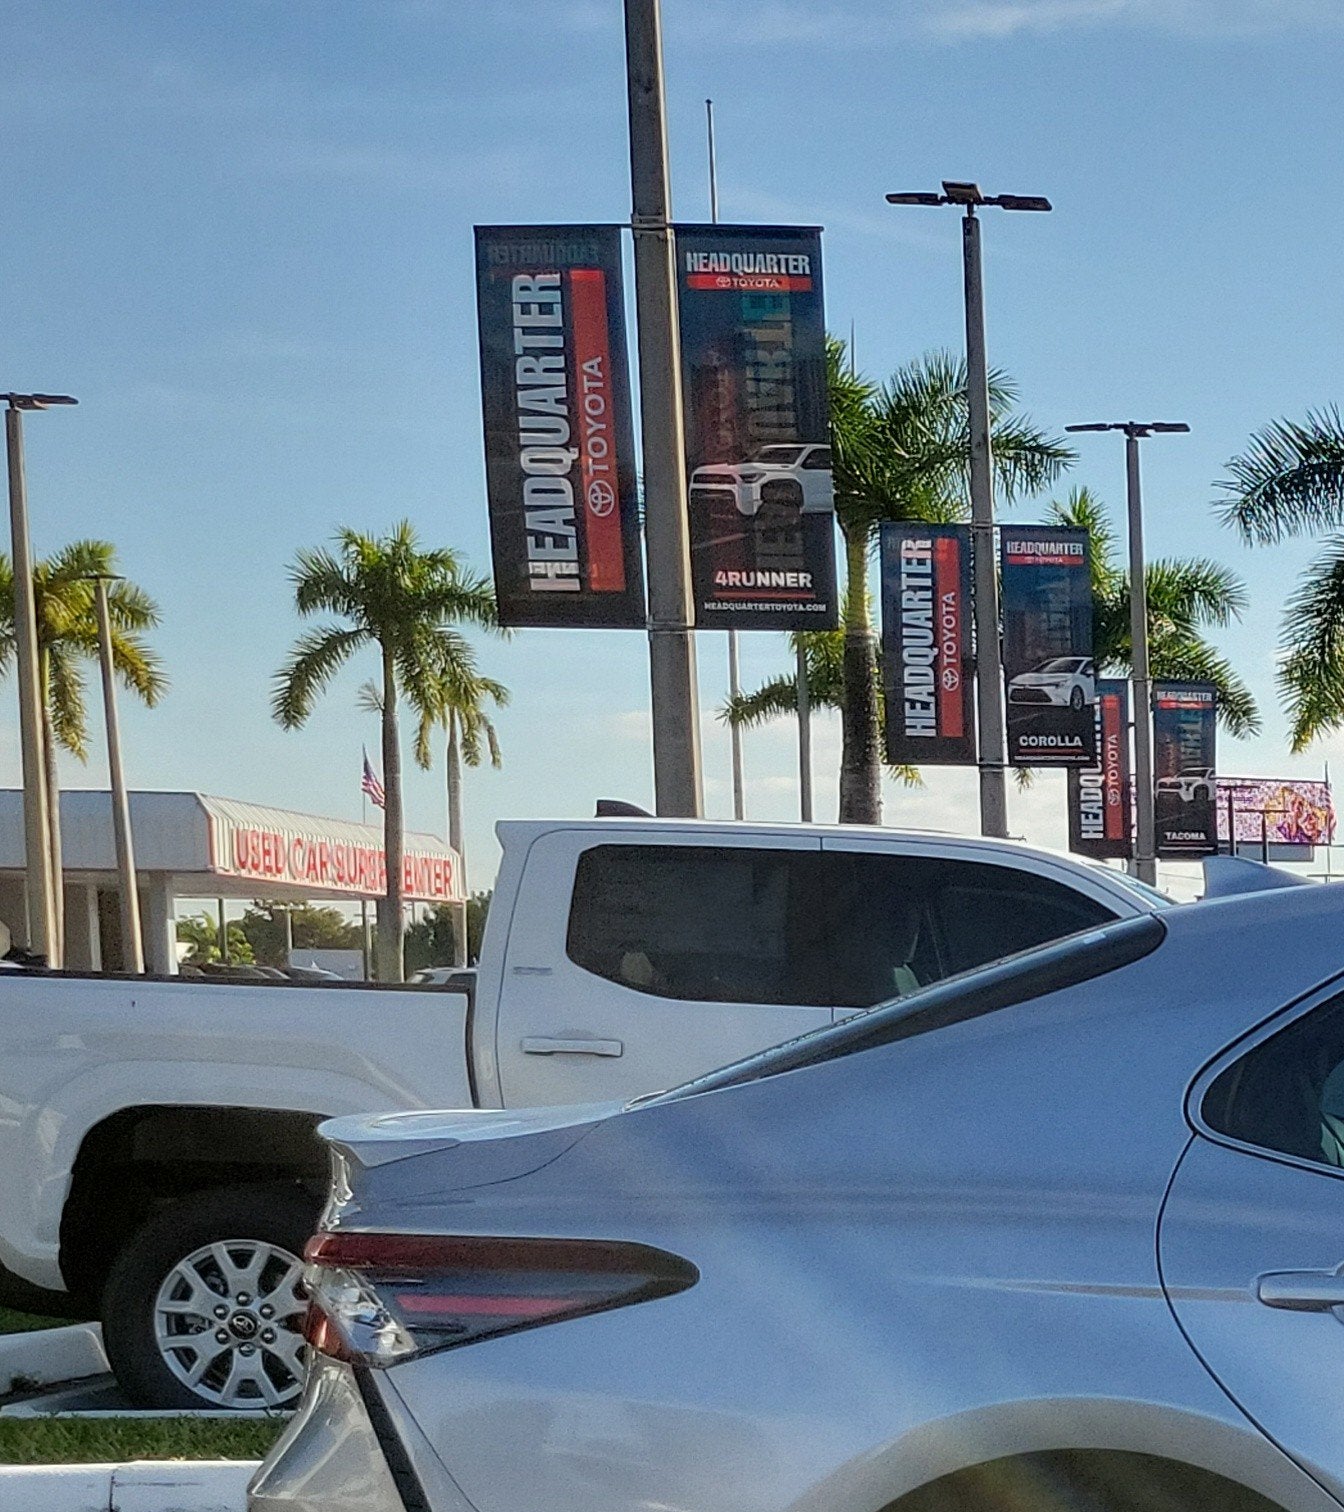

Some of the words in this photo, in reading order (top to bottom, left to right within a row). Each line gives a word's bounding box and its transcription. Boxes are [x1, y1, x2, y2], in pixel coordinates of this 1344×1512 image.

[686, 252, 811, 276] HEADQUARTER
[733, 277, 780, 289] TOYOTA
[510, 272, 582, 593] HEADQUARTER
[581, 356, 610, 472] TOYOTA
[1006, 541, 1084, 556] HEADQUARTER
[715, 571, 812, 588] 4RUNNER
[899, 537, 939, 738] HEADQUARTER
[941, 591, 957, 665] TOYOTA
[1019, 735, 1083, 747] COROLLA
[1107, 735, 1119, 787] TOYOTA
[1164, 831, 1207, 841] TACOMA
[234, 828, 286, 875] USED
[289, 837, 329, 882] CAR
[404, 853, 453, 896] ENTER
